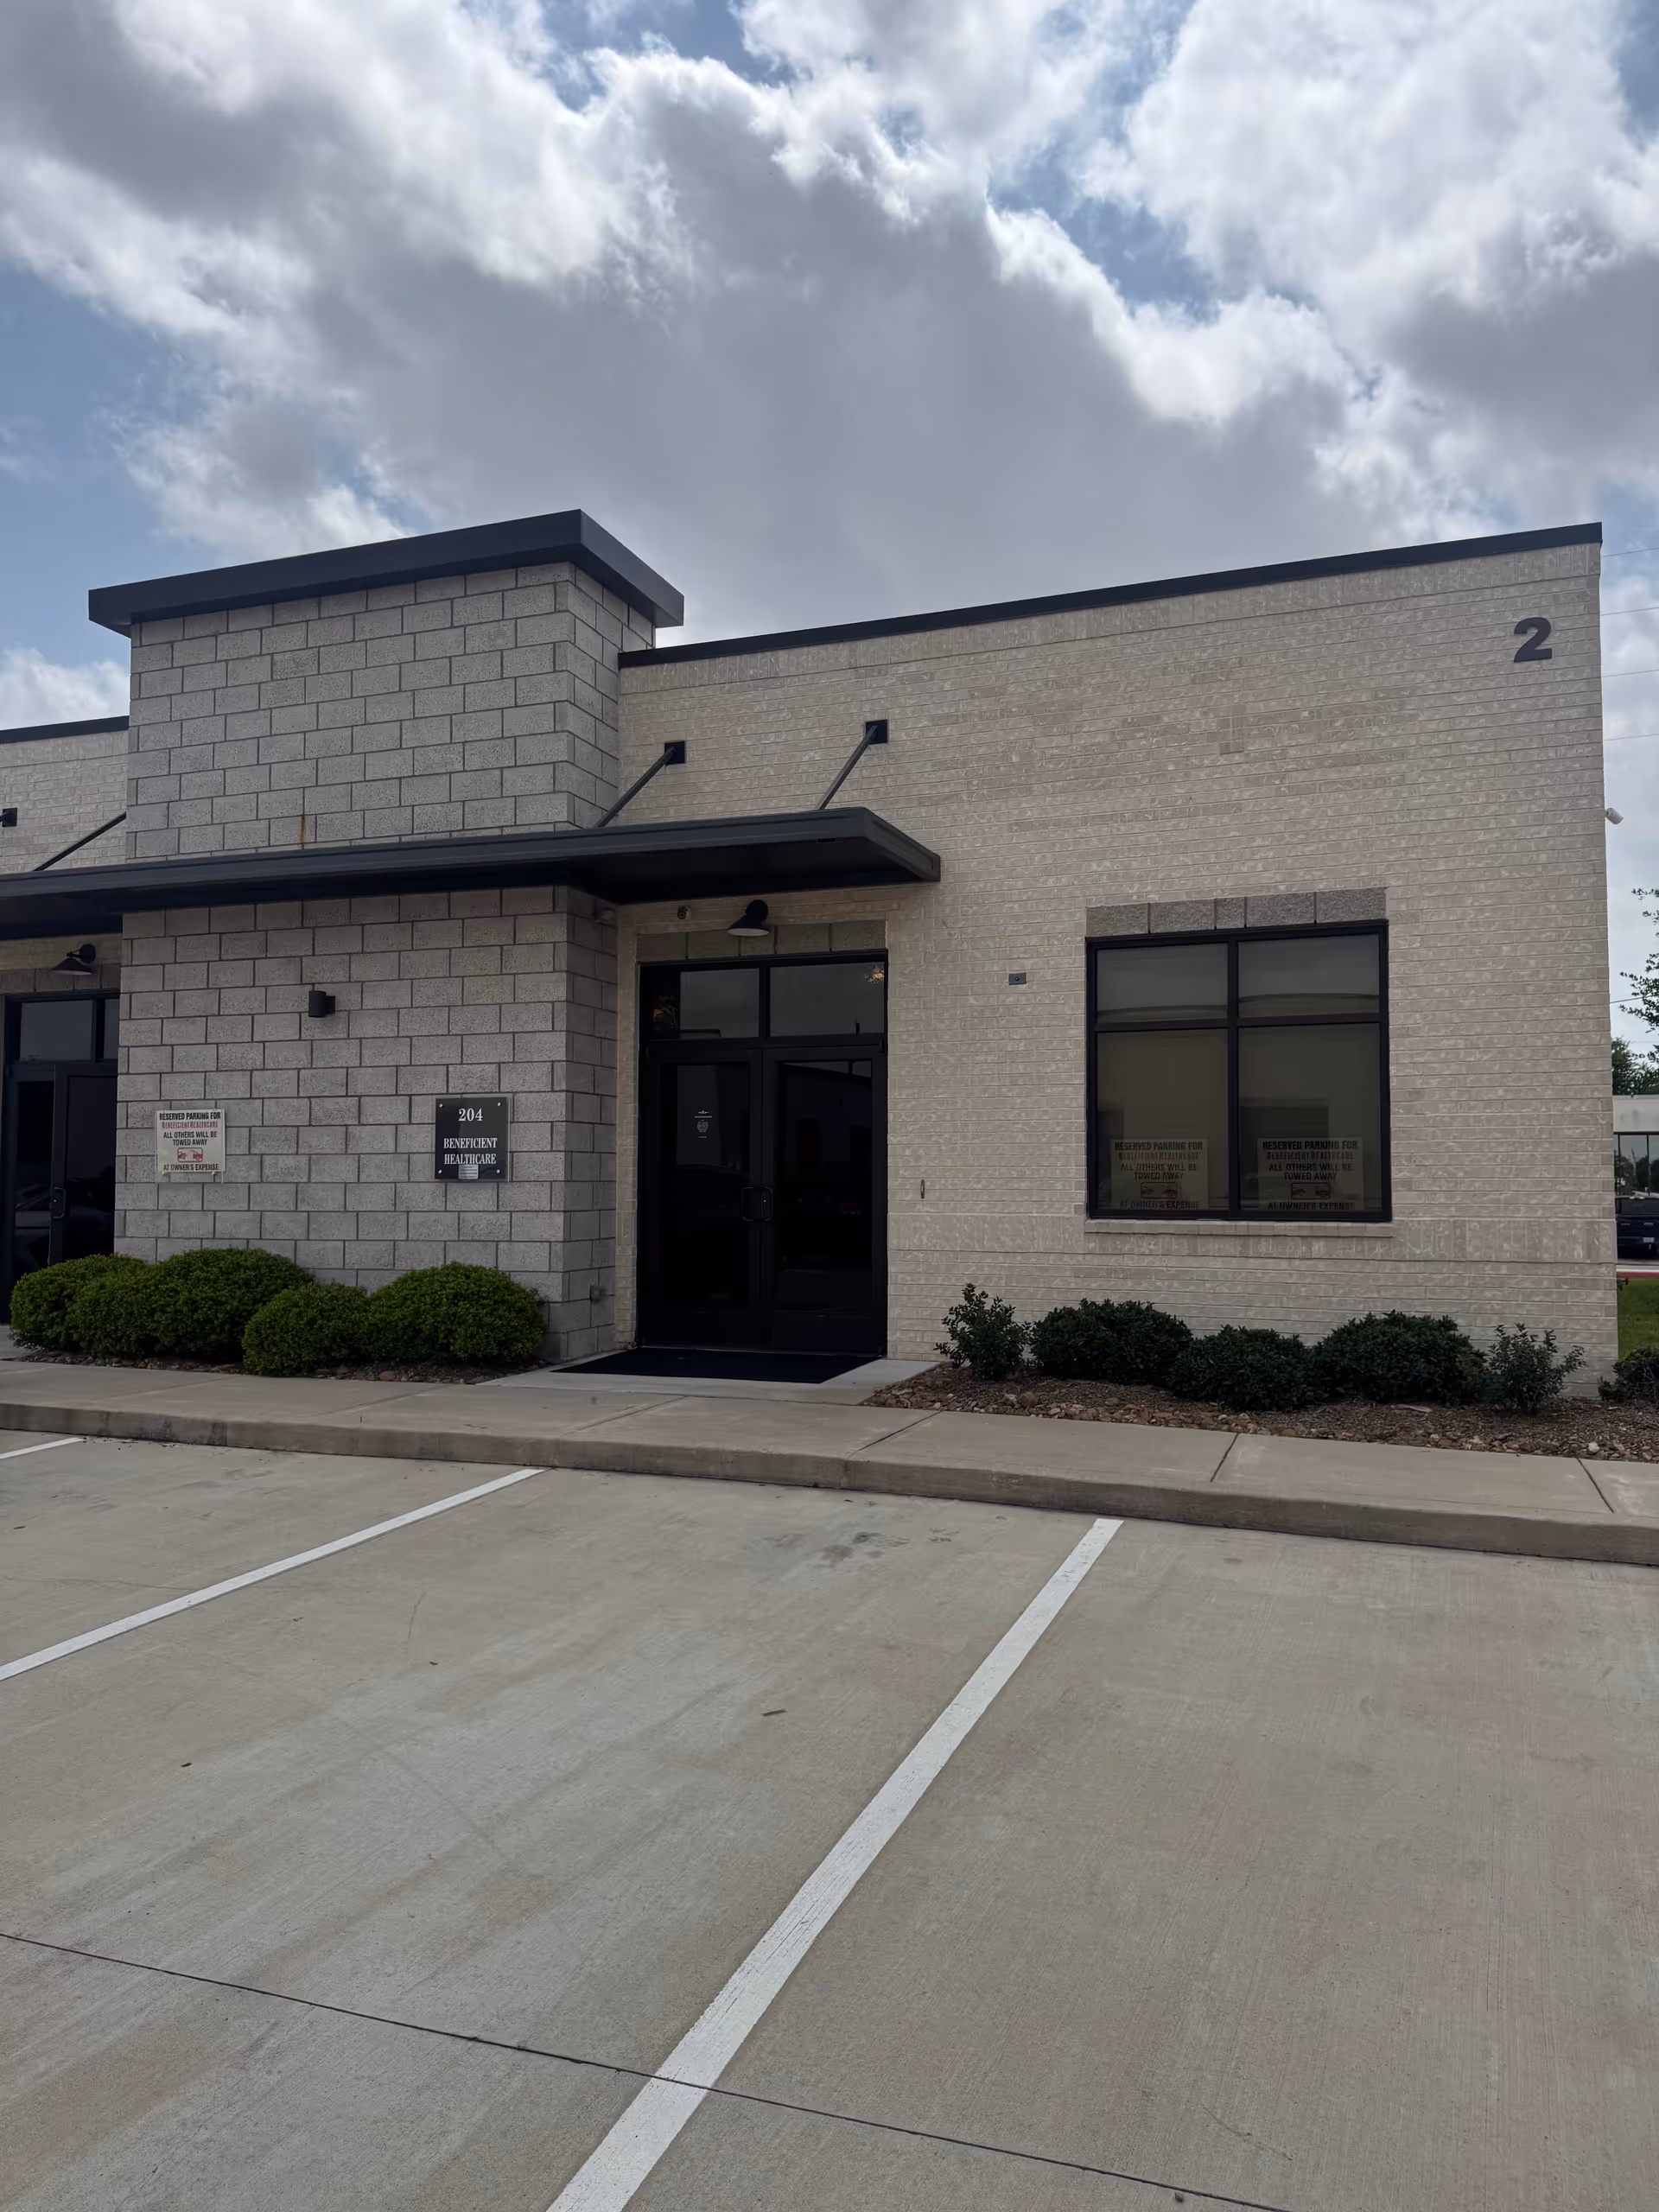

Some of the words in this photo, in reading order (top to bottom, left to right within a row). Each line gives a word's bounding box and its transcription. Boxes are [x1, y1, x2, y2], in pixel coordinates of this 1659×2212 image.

[1514, 617, 1552, 663] 2
[459, 1108, 483, 1121] 204
[443, 1138, 497, 1148] BENEFICIENT
[1262, 1141, 1301, 1150] RESERVED
[1305, 1141, 1339, 1149] PARKING
[1342, 1141, 1357, 1149] FOR
[444, 1154, 496, 1165] HEALTHCARE
